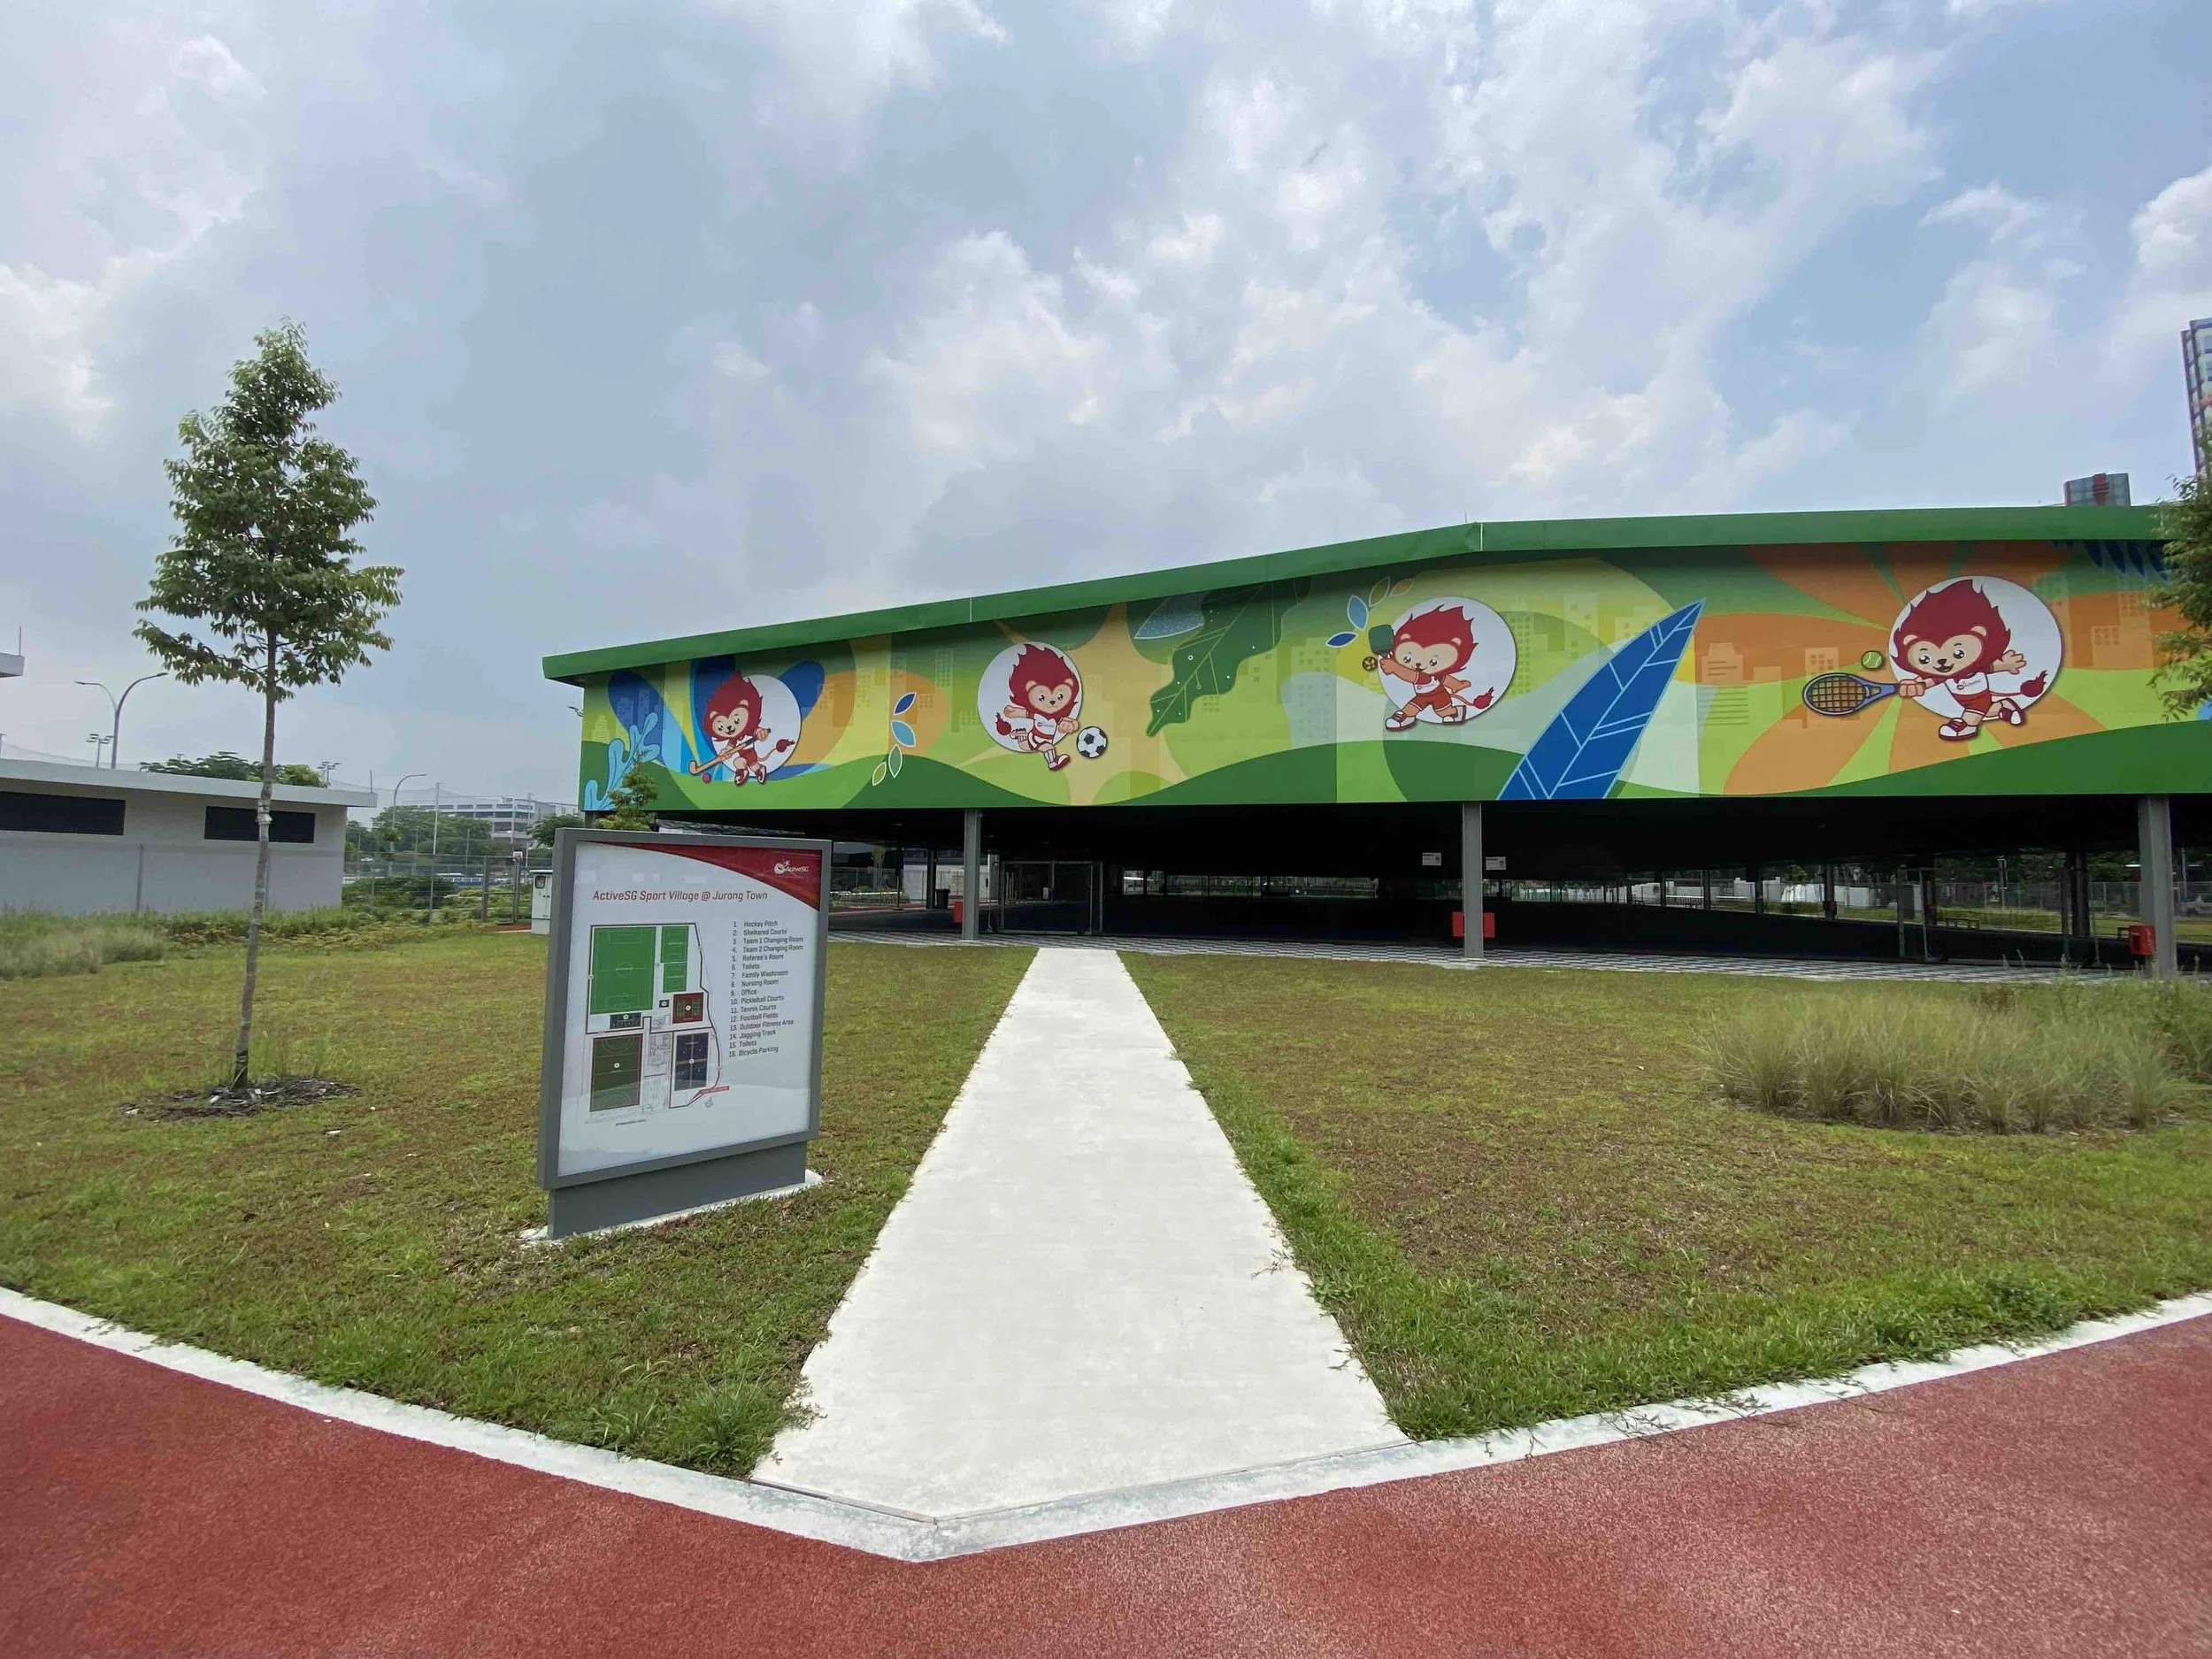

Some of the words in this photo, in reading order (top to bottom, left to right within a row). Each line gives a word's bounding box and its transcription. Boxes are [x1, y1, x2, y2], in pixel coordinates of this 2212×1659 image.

[593, 890, 637, 901] ActiveSG
[640, 891, 666, 902] Sport
[668, 891, 699, 902] Village
[701, 892, 710, 901] @
[712, 891, 743, 902] Jurong
[746, 891, 768, 900] Town
